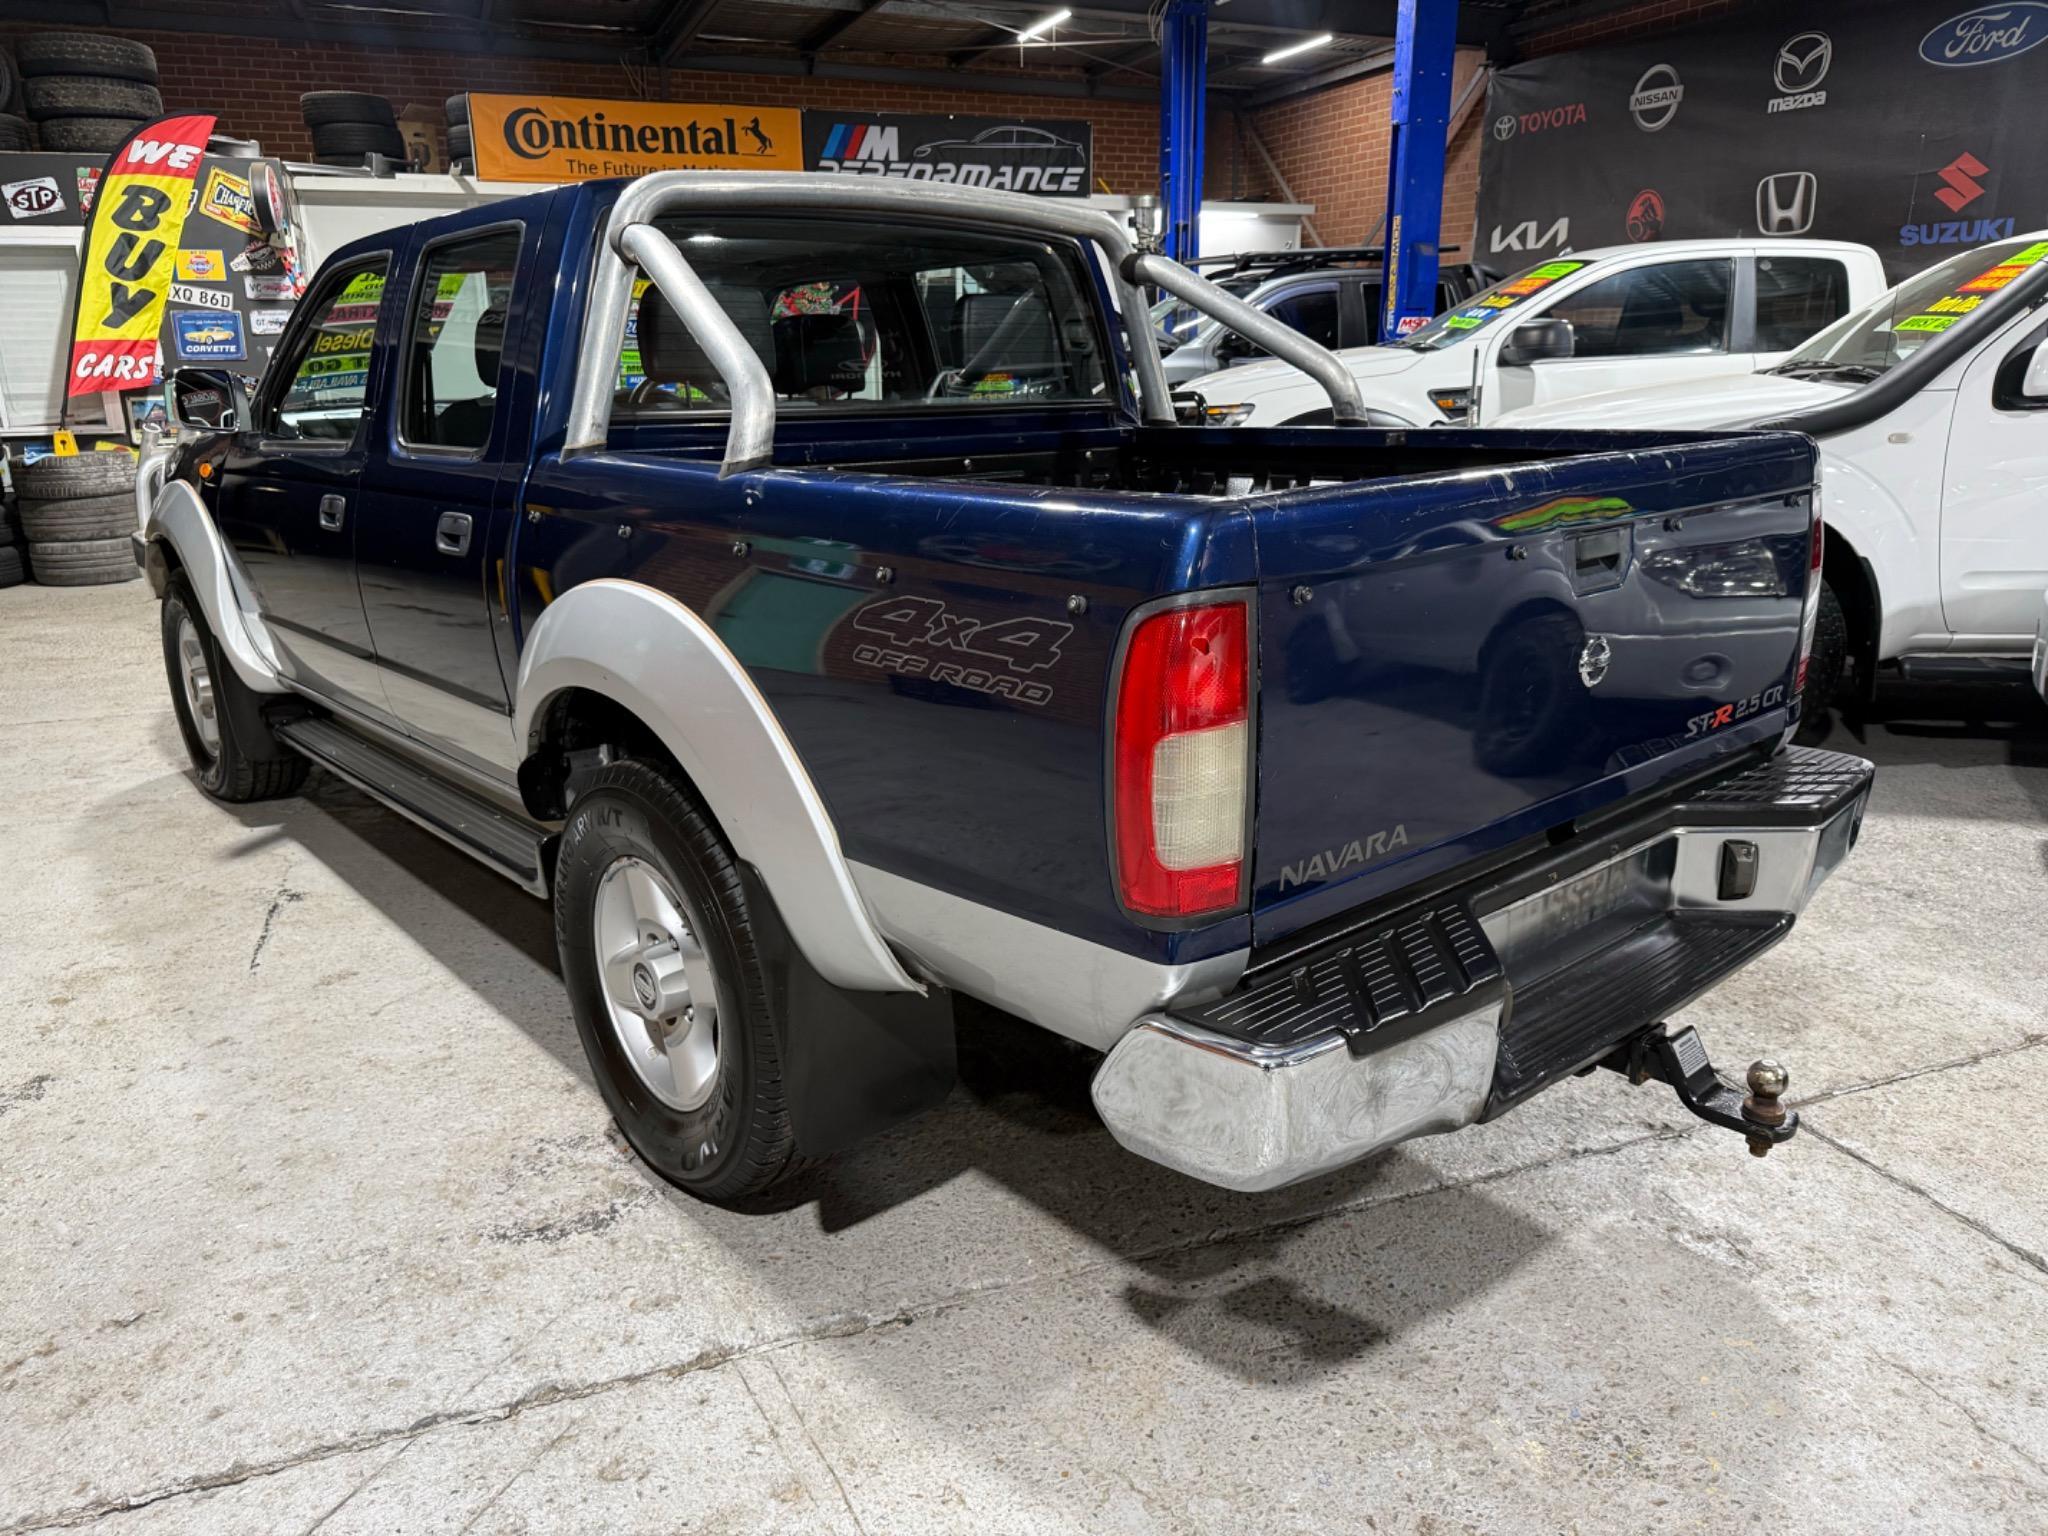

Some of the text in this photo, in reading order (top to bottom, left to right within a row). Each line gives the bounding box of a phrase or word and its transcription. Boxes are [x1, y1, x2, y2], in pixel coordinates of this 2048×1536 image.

[1944, 11, 2032, 58] Ford
[1634, 89, 1679, 107] NISSAN
[503, 106, 740, 160] Continental
[1519, 103, 1587, 135] TOYOTA
[566, 159, 598, 175] The
[604, 161, 658, 177] Future
[16, 186, 53, 209] STP
[214, 184, 254, 216] CHAMPIO
[1490, 217, 1569, 253] KIA
[1900, 217, 2015, 247] SUZUKI
[75, 140, 202, 381] WE BUY CARS
[171, 285, 193, 302] XQ
[186, 345, 236, 353] CORVETTE
[853, 595, 1075, 674] 4x4
[853, 644, 1053, 706] OFF ROAD
[1684, 685, 1784, 739] ST-R 2.5 CR
[1279, 823, 1409, 892] NAVARA
